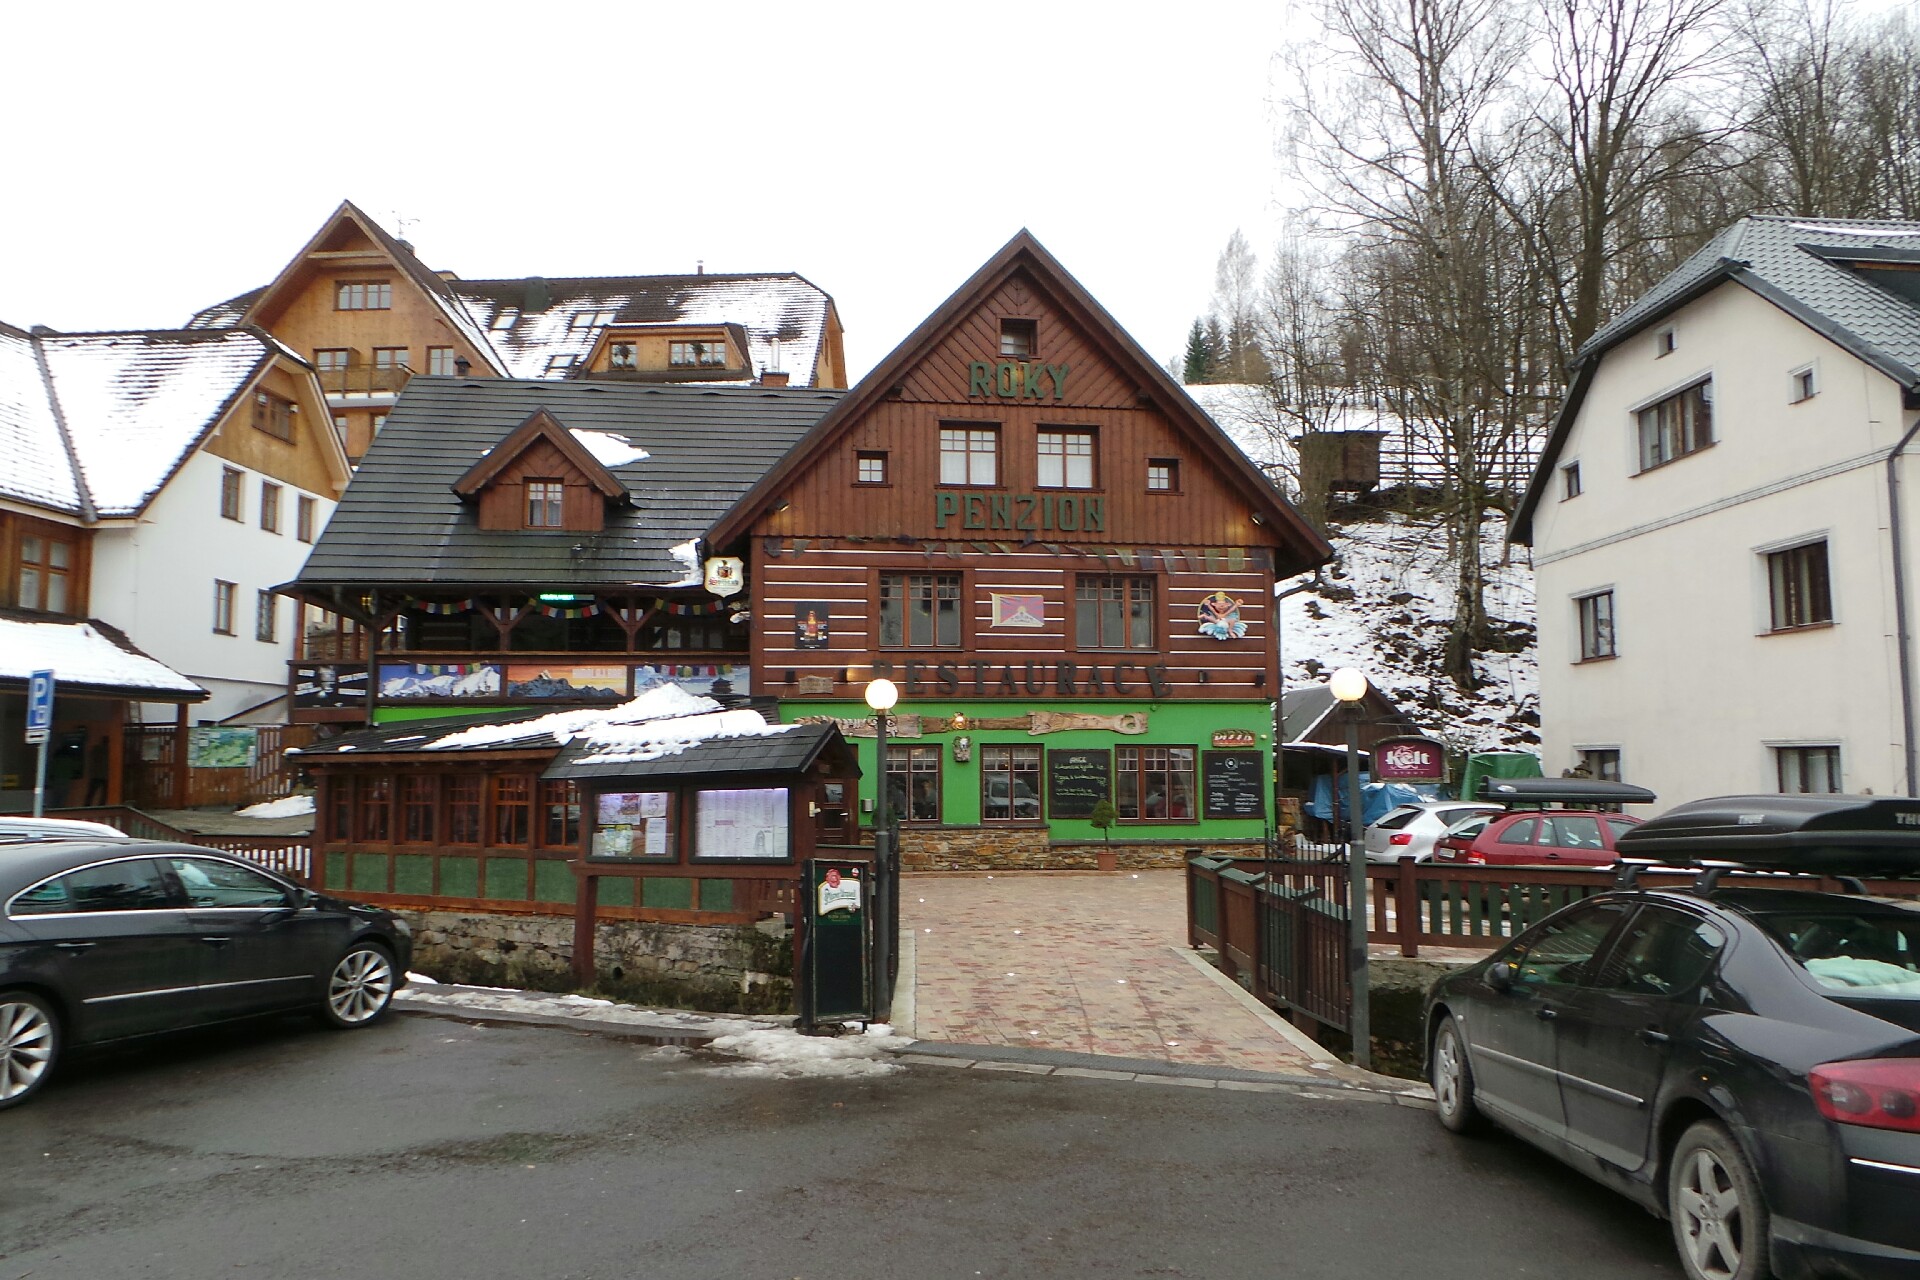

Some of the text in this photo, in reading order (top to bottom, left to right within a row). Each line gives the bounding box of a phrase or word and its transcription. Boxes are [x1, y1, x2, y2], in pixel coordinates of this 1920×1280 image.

[969, 361, 1070, 399] ROKY
[935, 493, 1105, 532] PENZION
[33, 677, 47, 710] P
[1385, 745, 1432, 769] Kelt
